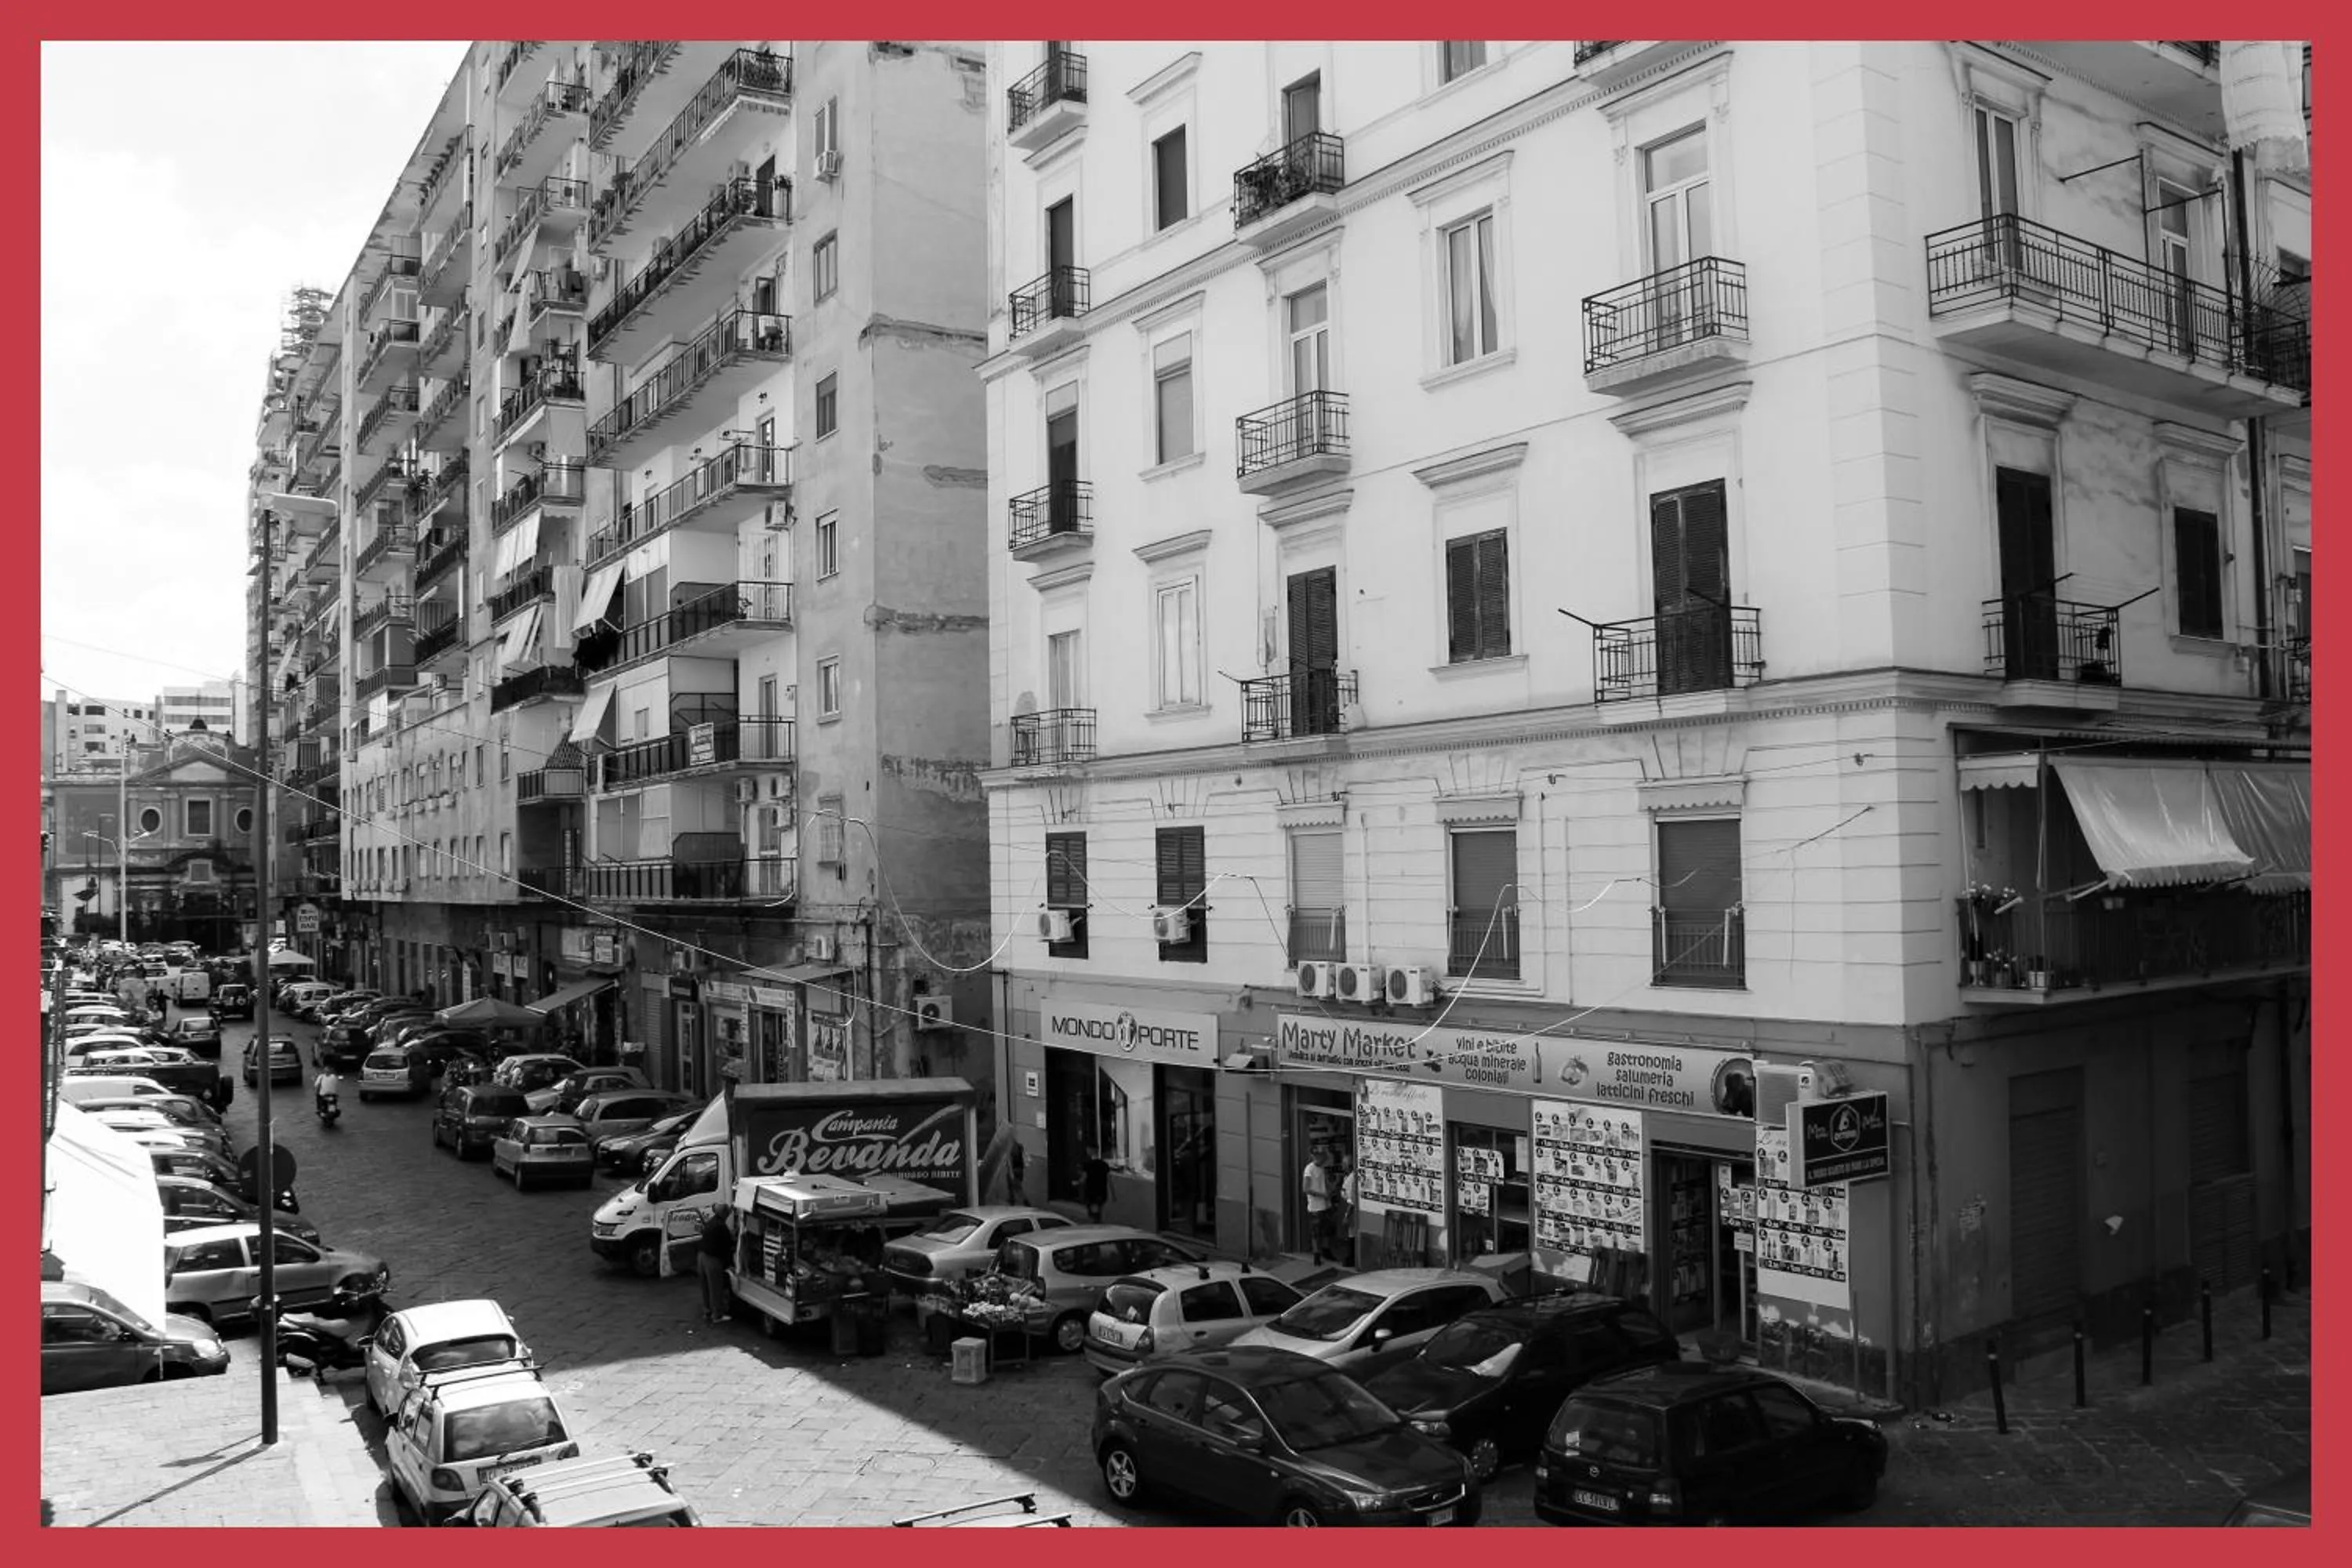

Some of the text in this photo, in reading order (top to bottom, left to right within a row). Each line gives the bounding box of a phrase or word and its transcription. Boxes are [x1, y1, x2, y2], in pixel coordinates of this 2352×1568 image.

[1051, 1015, 1199, 1051] MONDO PORTE
[1282, 1021, 1416, 1058] Marty Market
[1457, 1036, 1475, 1051] vini
[1482, 1054, 1526, 1072] minerale
[1607, 1051, 1682, 1072] gastronomia
[1465, 1069, 1509, 1084] coloniali
[1616, 1069, 1674, 1087] salumeria
[1597, 1082, 1694, 1107] latticini freschi
[811, 1110, 899, 1142] Campania
[757, 1126, 961, 1174] Bevanda
